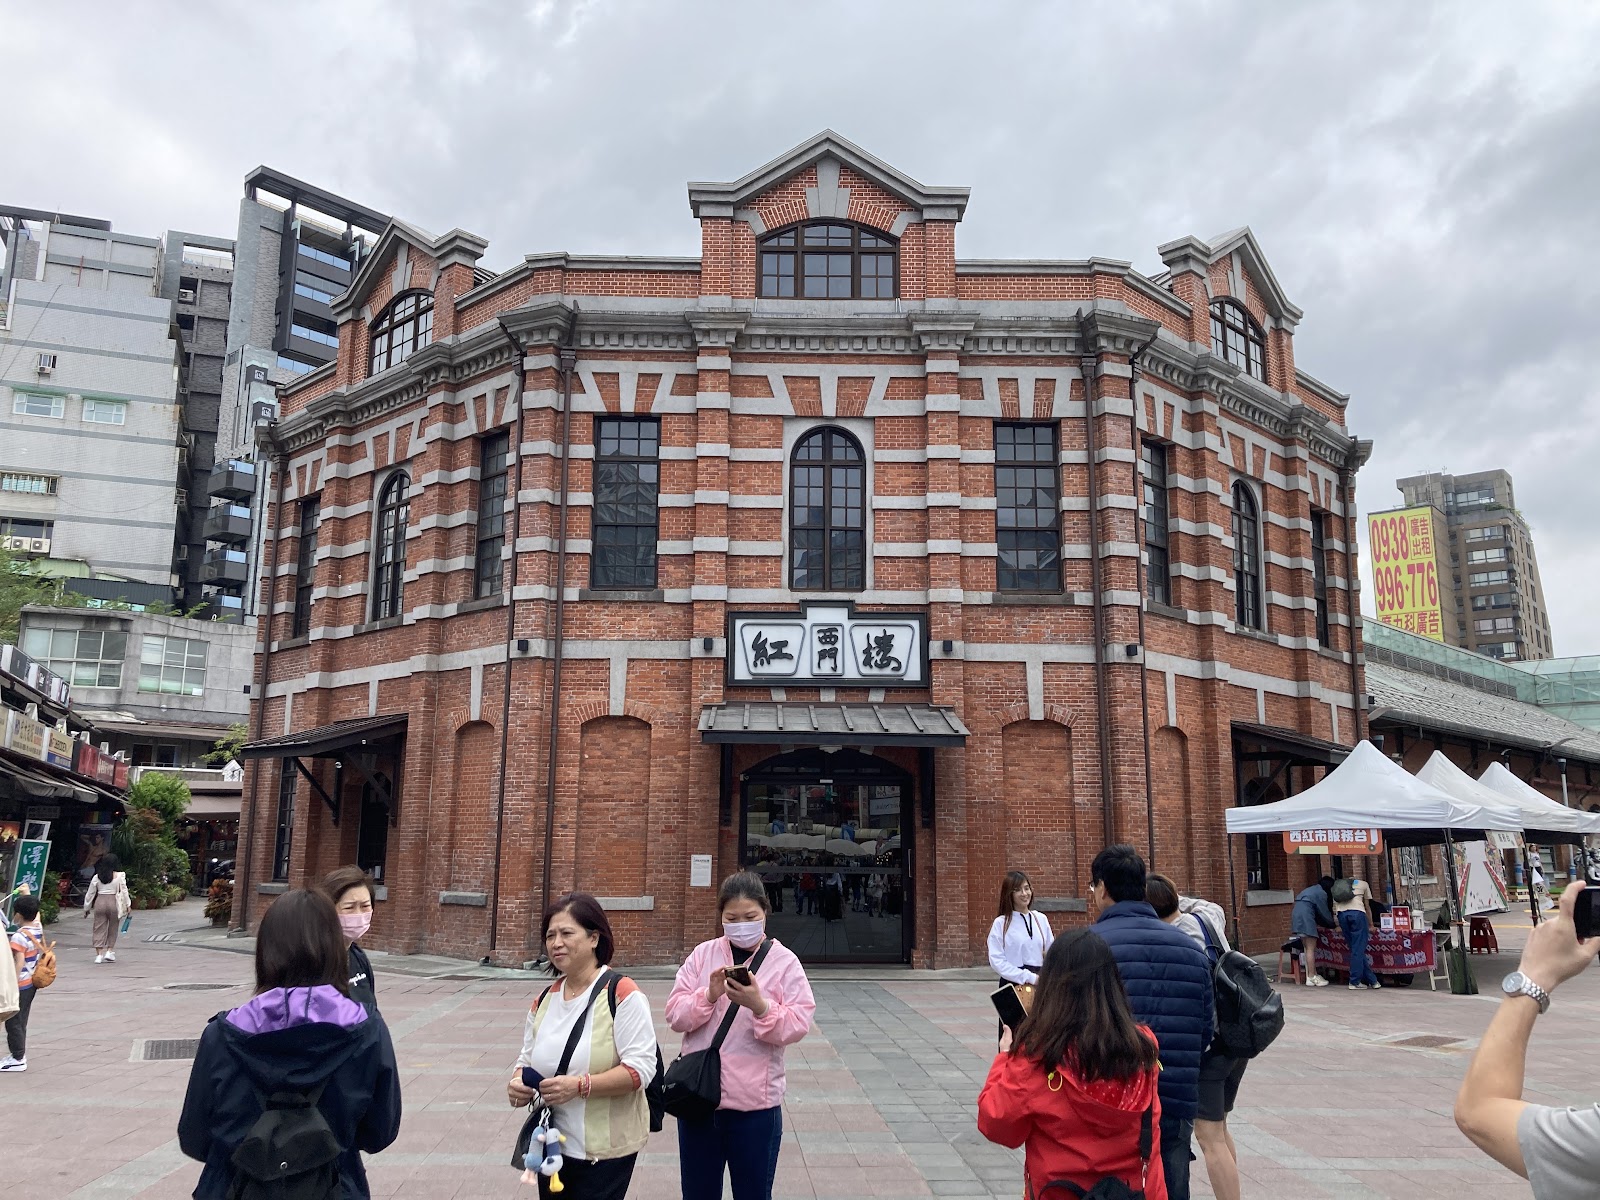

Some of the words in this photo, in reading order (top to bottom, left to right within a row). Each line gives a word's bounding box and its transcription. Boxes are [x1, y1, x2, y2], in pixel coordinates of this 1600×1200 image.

[1410, 517, 1429, 536] 廣告
[1372, 516, 1409, 563] 0938
[1412, 537, 1432, 557] 出租
[752, 630, 793, 668] 紅
[816, 627, 839, 672] 西門
[862, 628, 902, 671] 樓
[1290, 829, 1367, 842] 西紅市服務台
